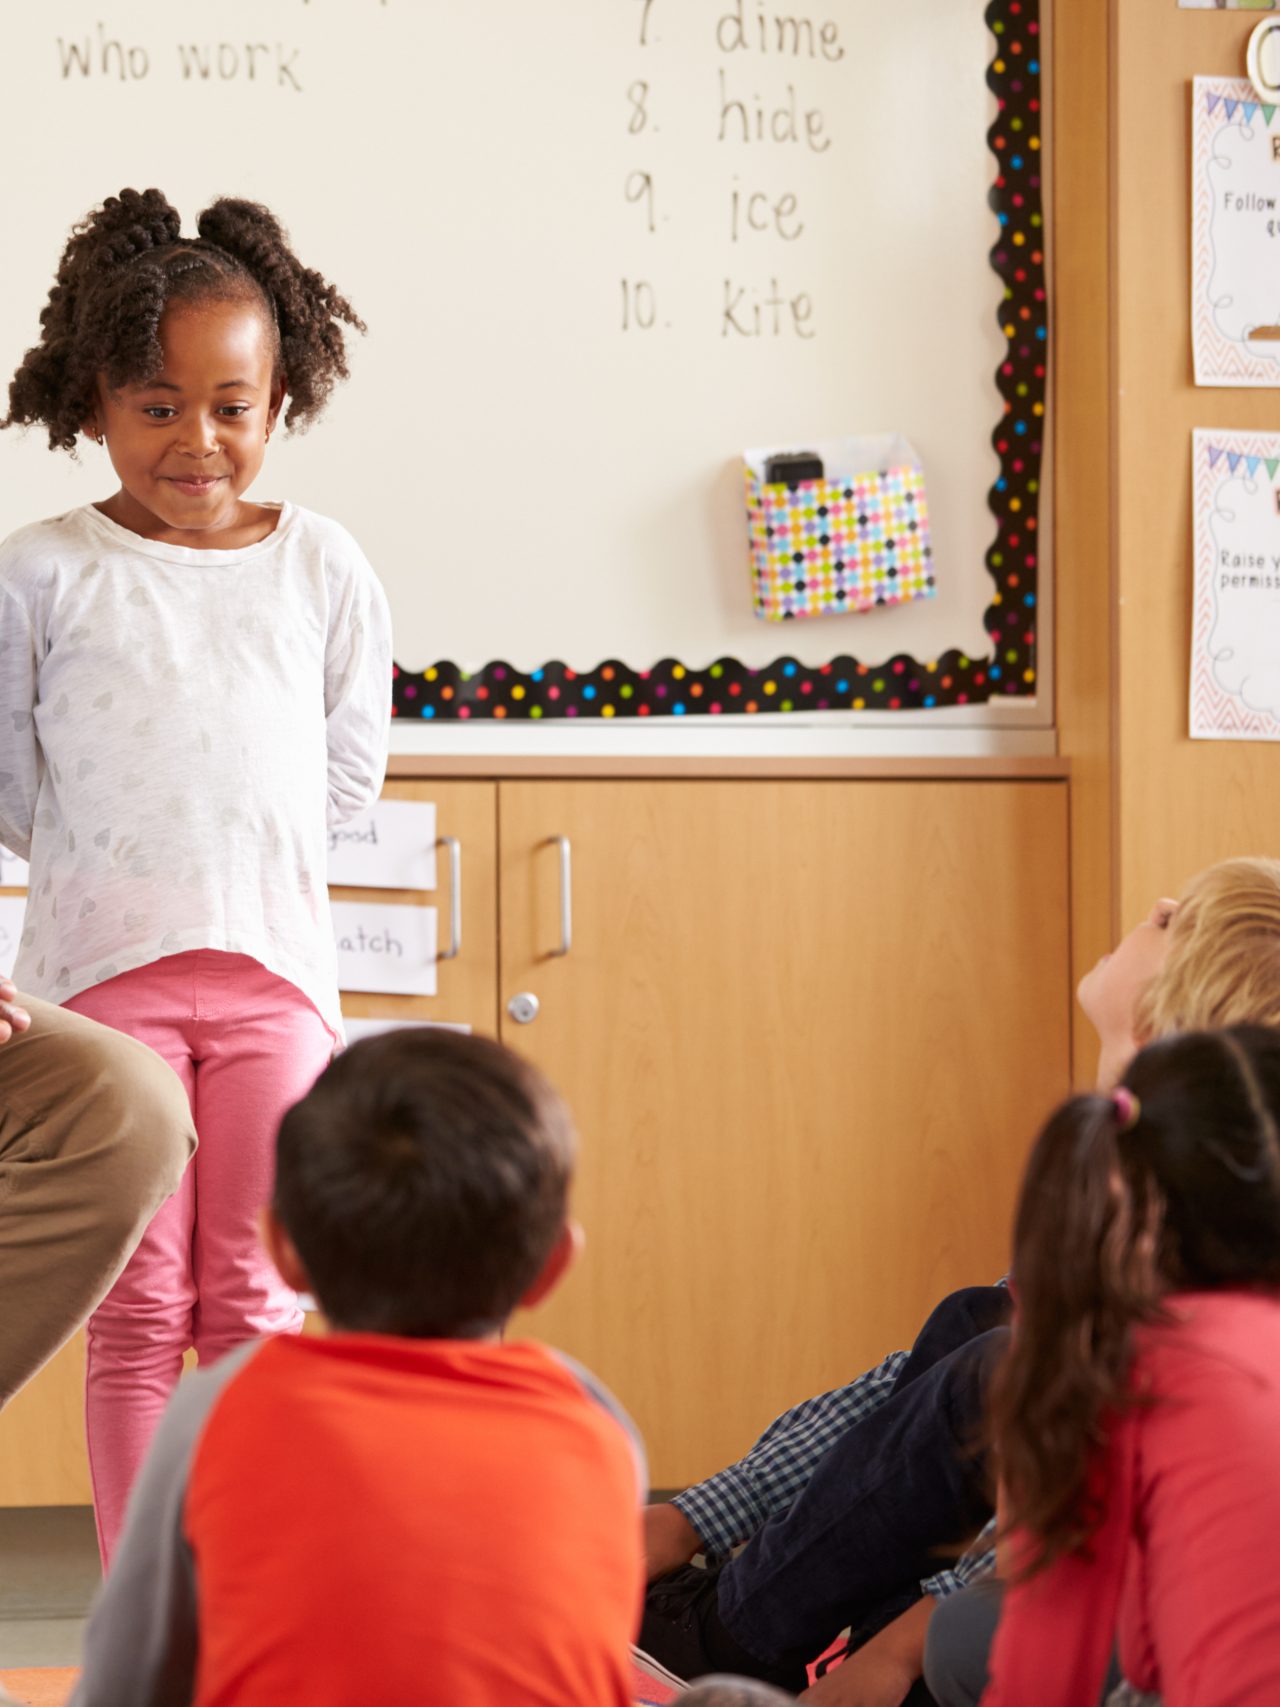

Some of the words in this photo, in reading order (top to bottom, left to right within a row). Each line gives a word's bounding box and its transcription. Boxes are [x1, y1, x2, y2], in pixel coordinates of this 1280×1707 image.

[56, 21, 151, 82] who
[177, 42, 303, 92] work
[716, 0, 845, 62] dime
[626, 80, 661, 136] 8.
[718, 67, 831, 153] hide
[624, 170, 670, 233] 9.
[730, 173, 805, 242] ice
[1223, 191, 1276, 212] Follow
[620, 278, 672, 331] 10.
[721, 277, 816, 339] kite
[1221, 549, 1265, 569] Raise
[337, 924, 403, 957] atch
